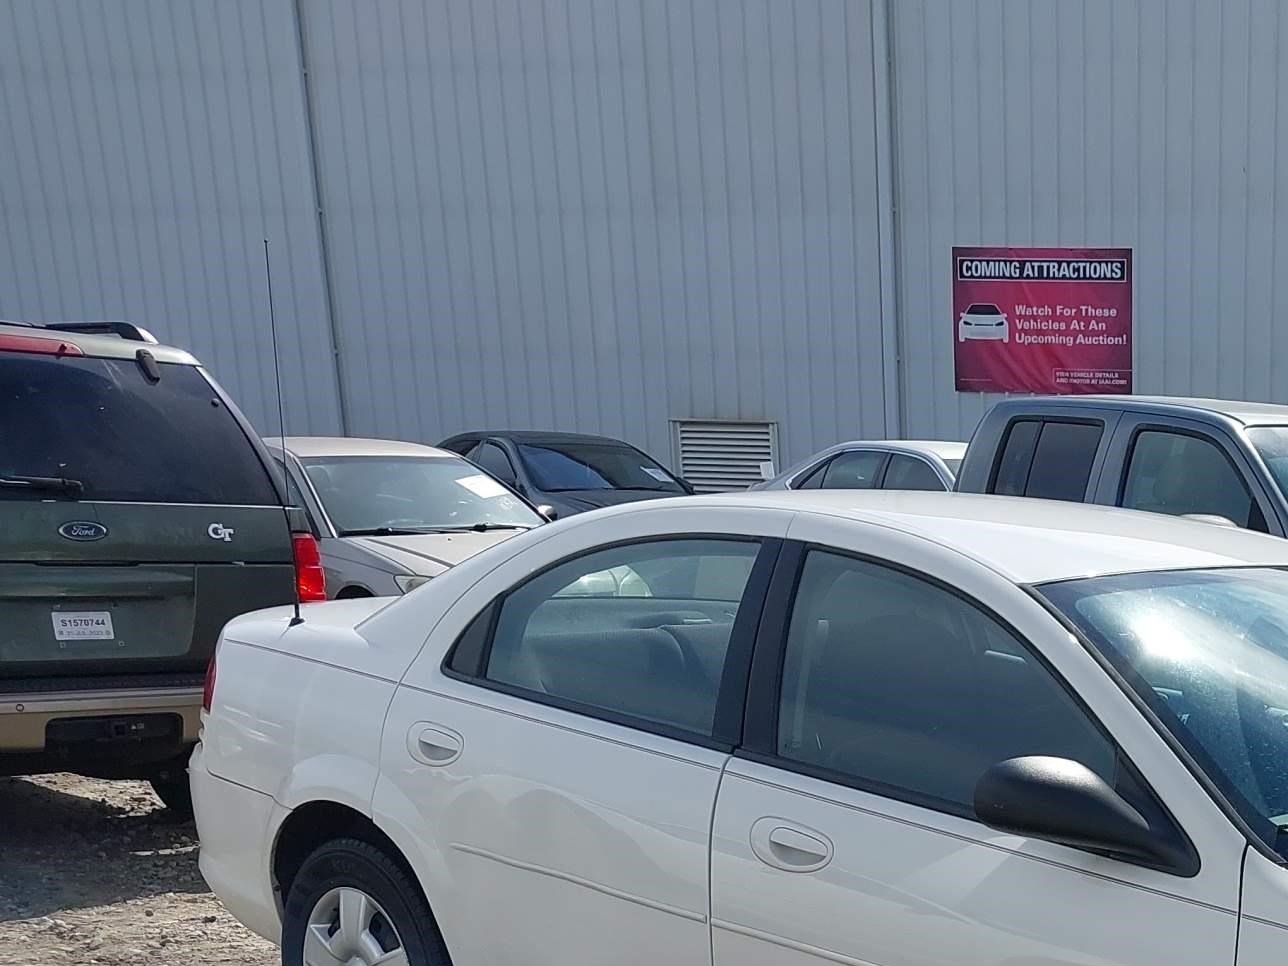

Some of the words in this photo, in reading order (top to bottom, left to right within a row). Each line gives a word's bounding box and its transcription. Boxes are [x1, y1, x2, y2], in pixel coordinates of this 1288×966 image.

[962, 260, 1020, 277] COMING
[1023, 262, 1122, 279] ATTRACTIONS
[1015, 305, 1052, 316] Watch
[1056, 305, 1076, 316] For
[1080, 305, 1117, 317] These
[1015, 319, 1066, 330] Vehicles
[1070, 320, 1086, 330] At
[1088, 320, 1106, 331] An
[1015, 333, 1073, 346] Upcoming
[1075, 334, 1127, 345] Auction!
[71, 525, 96, 536] Ford
[208, 523, 234, 541] GT
